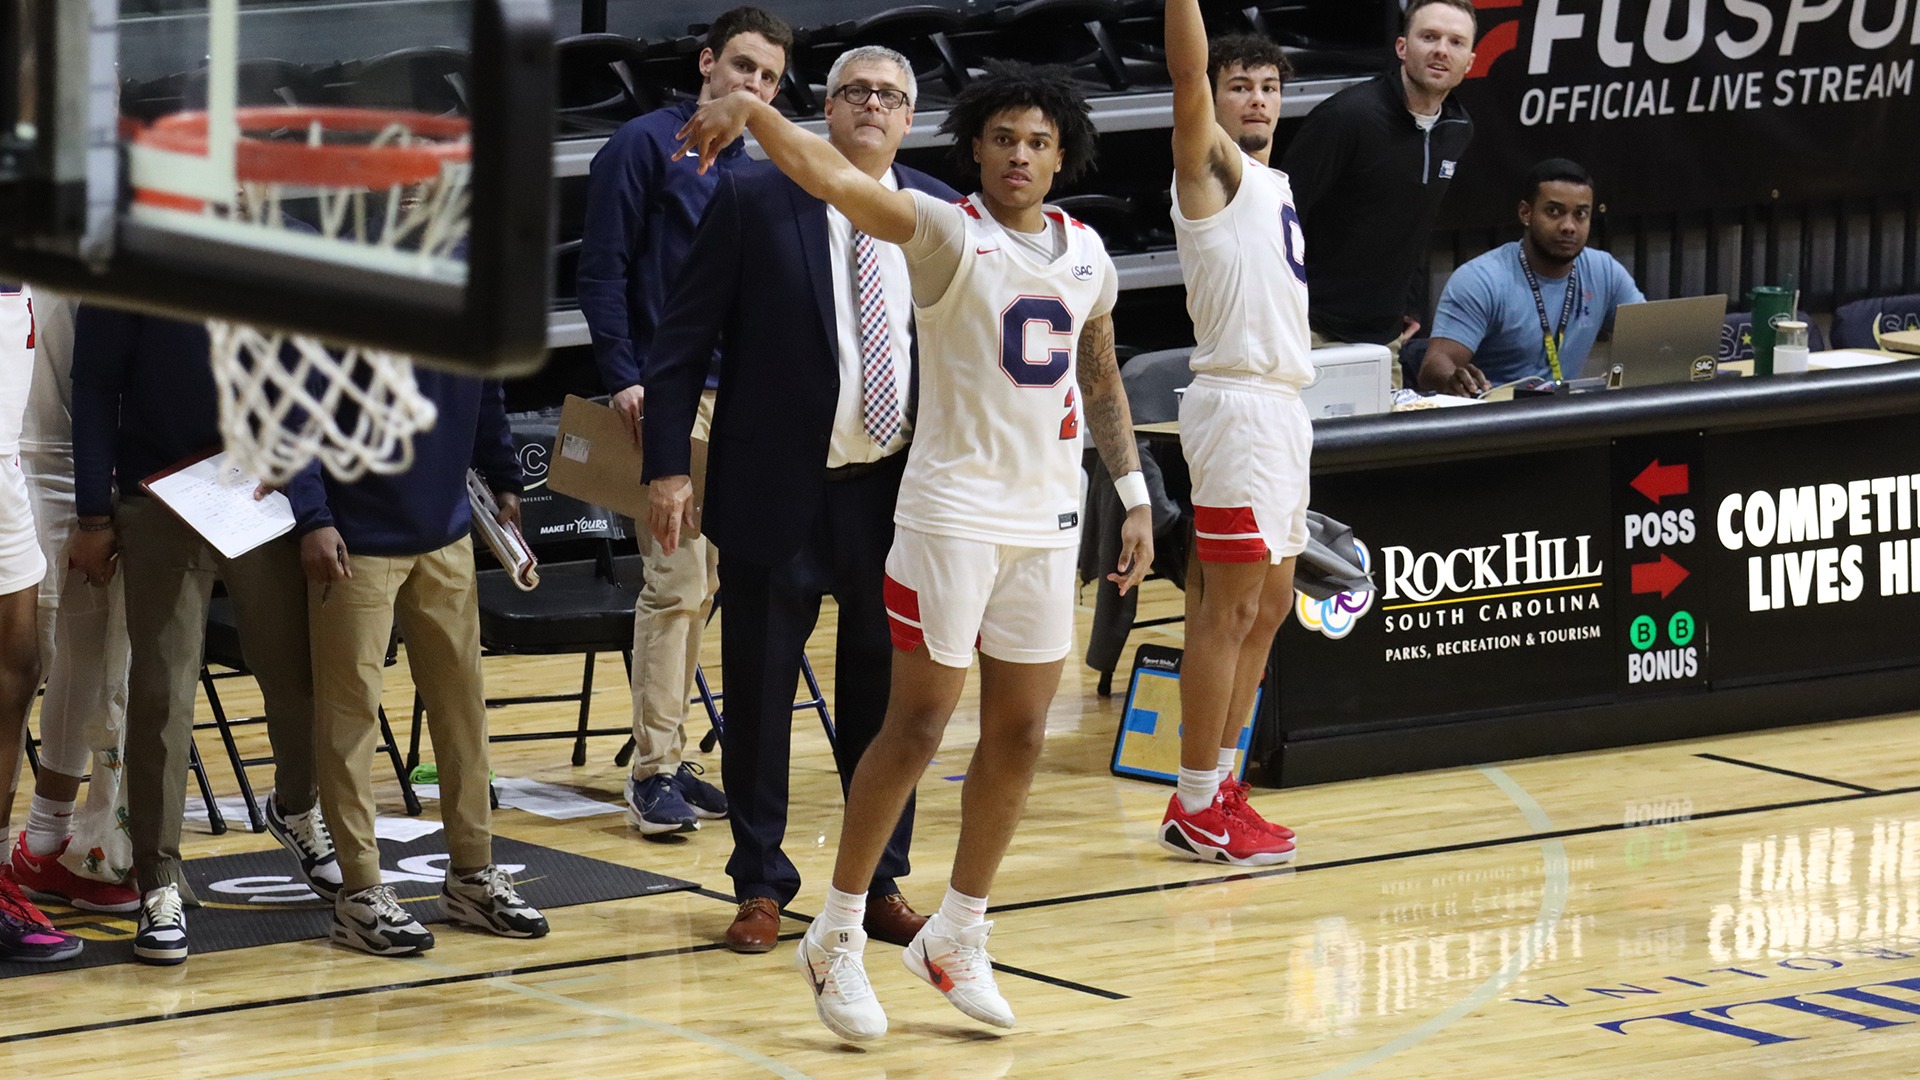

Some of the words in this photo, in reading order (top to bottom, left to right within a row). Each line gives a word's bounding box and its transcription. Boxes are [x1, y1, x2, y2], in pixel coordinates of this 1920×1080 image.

[1519, 78, 1675, 127] OFFICIAL
[1686, 71, 1764, 113] LIVE
[1773, 59, 1914, 107] STREAM
[1074, 264, 1093, 276] SAC
[999, 294, 1074, 388] C
[1695, 360, 1713, 371] SAC
[1059, 386, 1079, 440] 2
[519, 495, 553, 503] ONFERENCE
[540, 524, 565, 535] MAKE
[566, 523, 575, 532] IT
[574, 516, 608, 534] YOURS
[1625, 508, 1697, 549] POSS
[1748, 544, 1864, 612] LIVES
[1385, 609, 1465, 633] SOUTH
[1479, 592, 1601, 622] CAROLINA
[1385, 645, 1432, 662] PARKS,
[1436, 634, 1521, 657] RECREATION
[1525, 632, 1536, 646] &
[1539, 624, 1601, 645] TOURISM
[1627, 647, 1698, 684] BONUS
[1510, 940, 1920, 1008] ROLINA
